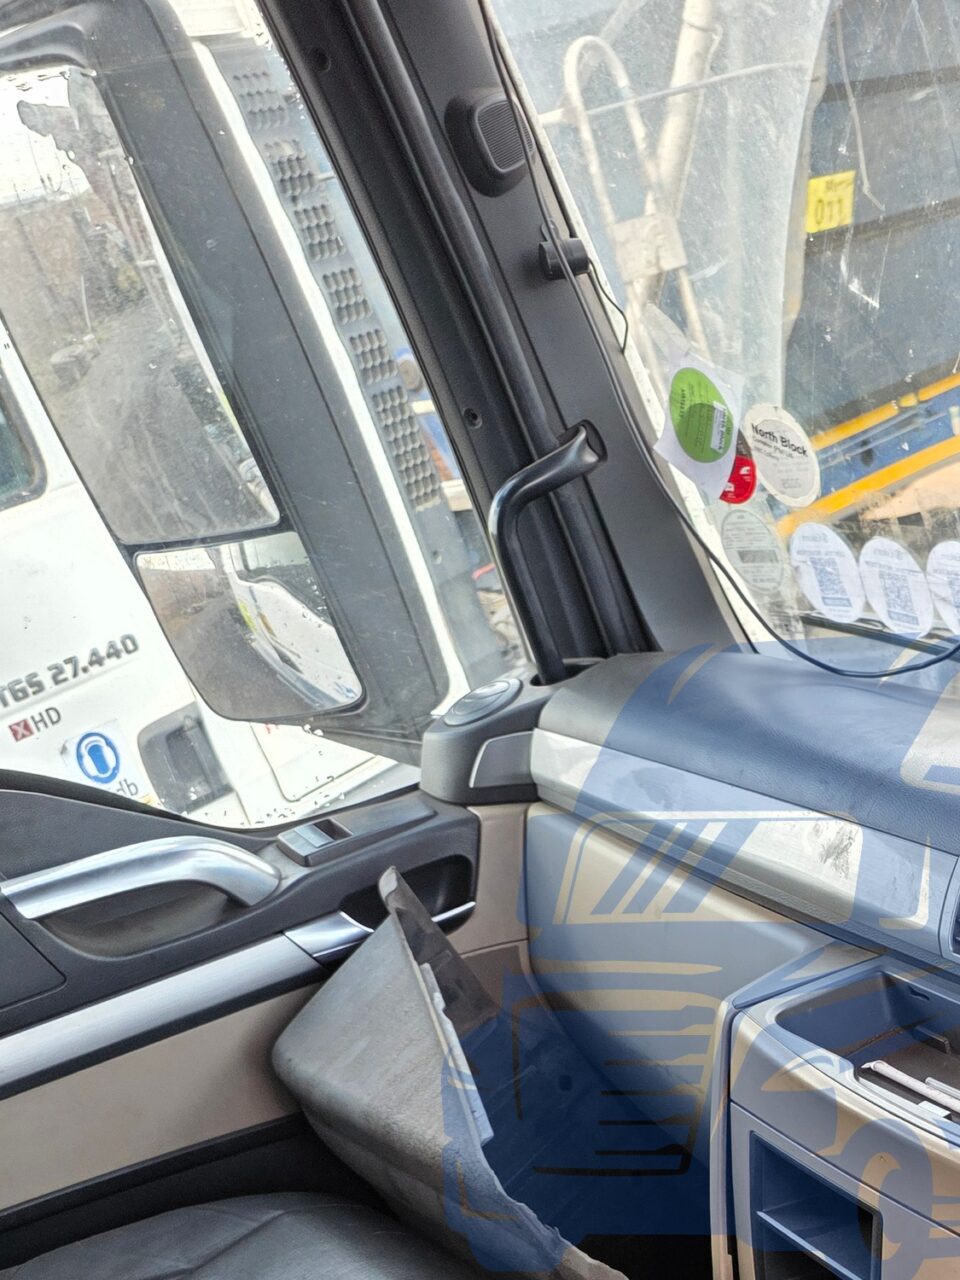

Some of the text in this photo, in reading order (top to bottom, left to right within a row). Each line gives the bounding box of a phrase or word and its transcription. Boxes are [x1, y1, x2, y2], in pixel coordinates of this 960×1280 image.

[751, 423, 778, 443] North
[780, 436, 808, 457] Block
[47, 634, 140, 686] 27.440
